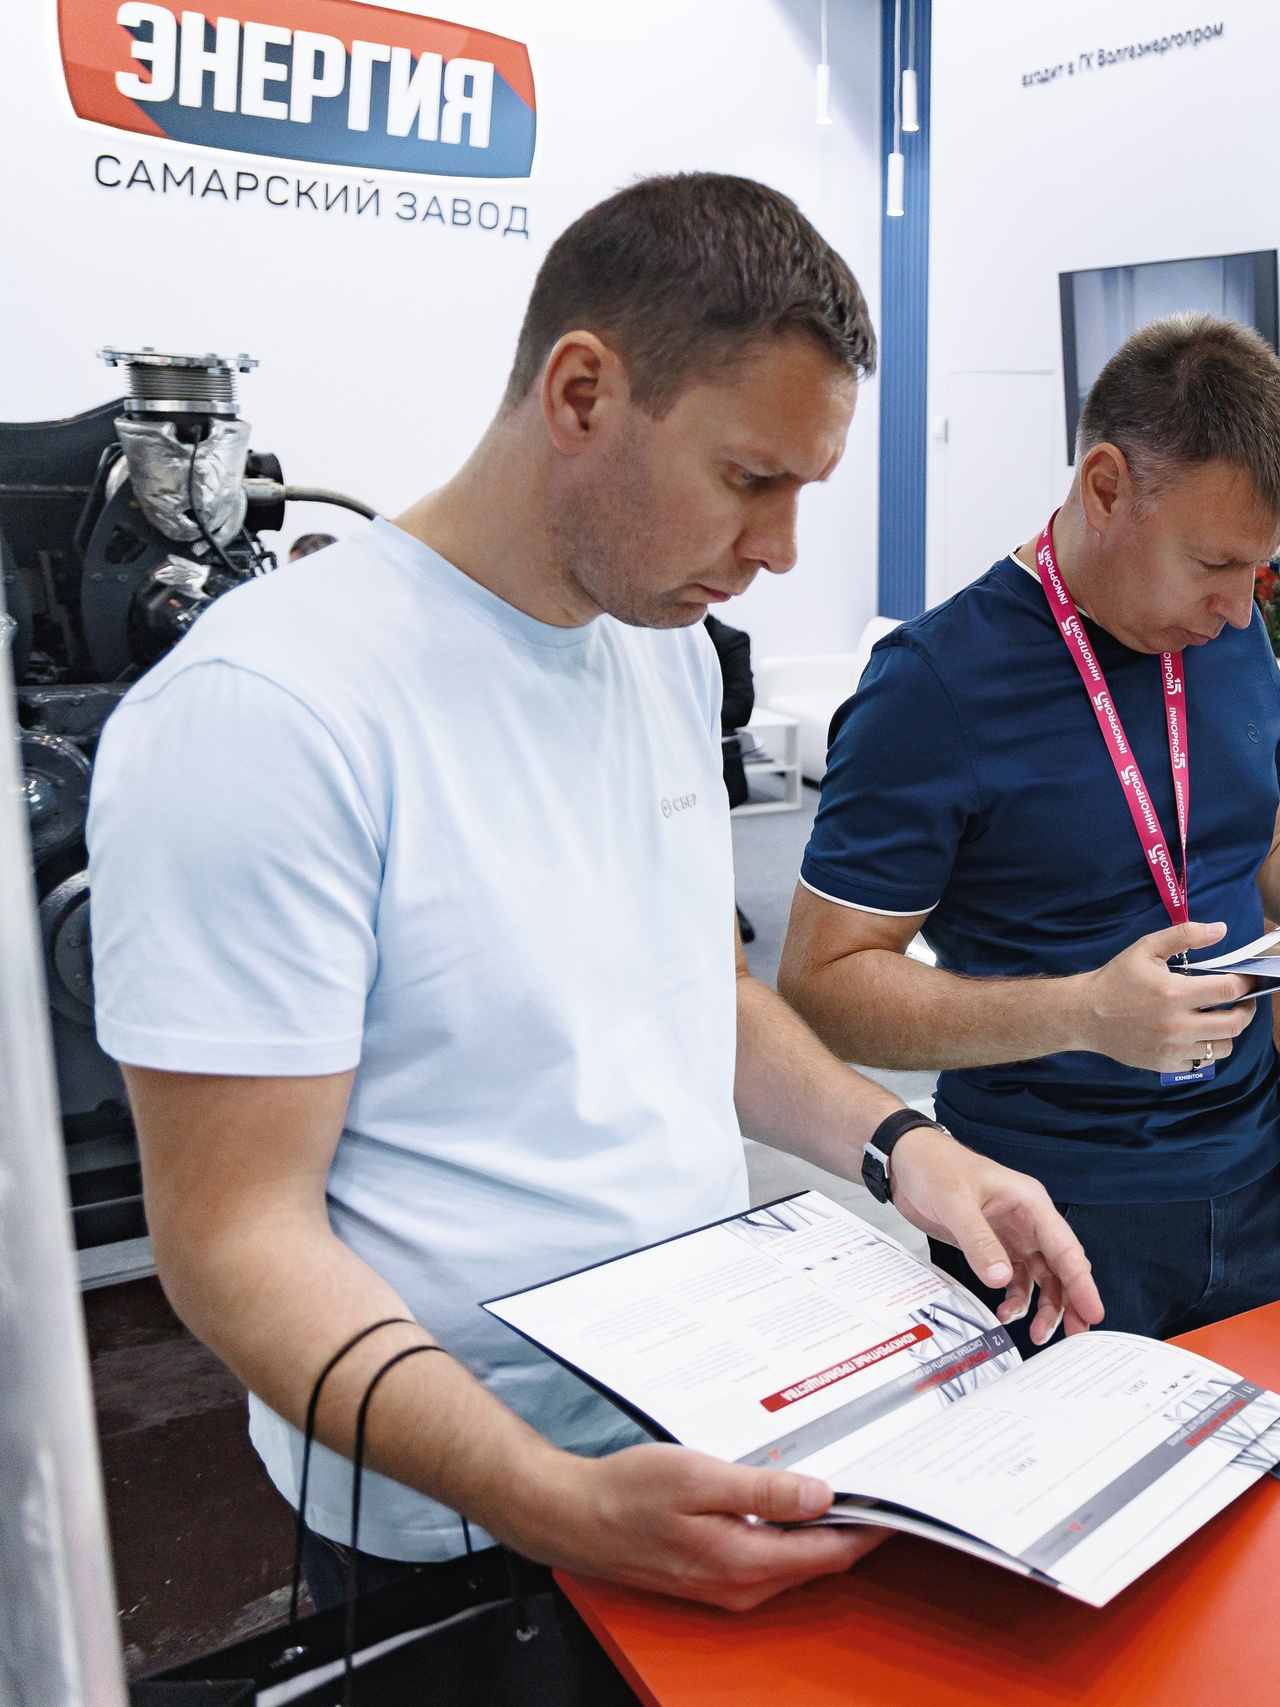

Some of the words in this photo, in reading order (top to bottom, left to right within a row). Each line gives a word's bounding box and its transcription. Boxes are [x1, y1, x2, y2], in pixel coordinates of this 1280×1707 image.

[116, 1, 495, 149] ЭНЕРГИЯ
[1022, 64, 1064, 87] входит
[1068, 62, 1074, 76] в
[1079, 52, 1094, 72] ГК
[94, 155, 380, 217] САМАРСКИЙ
[396, 192, 530, 239] ЗАВОД
[1044, 551, 1068, 605] INNOPROM
[1070, 622, 1101, 681] ИННОПРОМ
[1102, 698, 1128, 754] INNOPROM
[1169, 707, 1180, 763] INNOPROM
[1129, 770, 1158, 833] ИННОПРОМ
[1157, 849, 1180, 907] INNOPROM
[851, 1331, 917, 1367] КОНКУРЕНТНЫЕ
[929, 1350, 958, 1371] ЗАЩИТЫ
[954, 1338, 983, 1357] СИСТЕМА
[991, 1333, 1005, 1346] 12
[779, 1360, 856, 1401] ПРЕИМУЩЕСТВА
[922, 1364, 932, 1375] ОТ
[1239, 1384, 1256, 1393] 11
